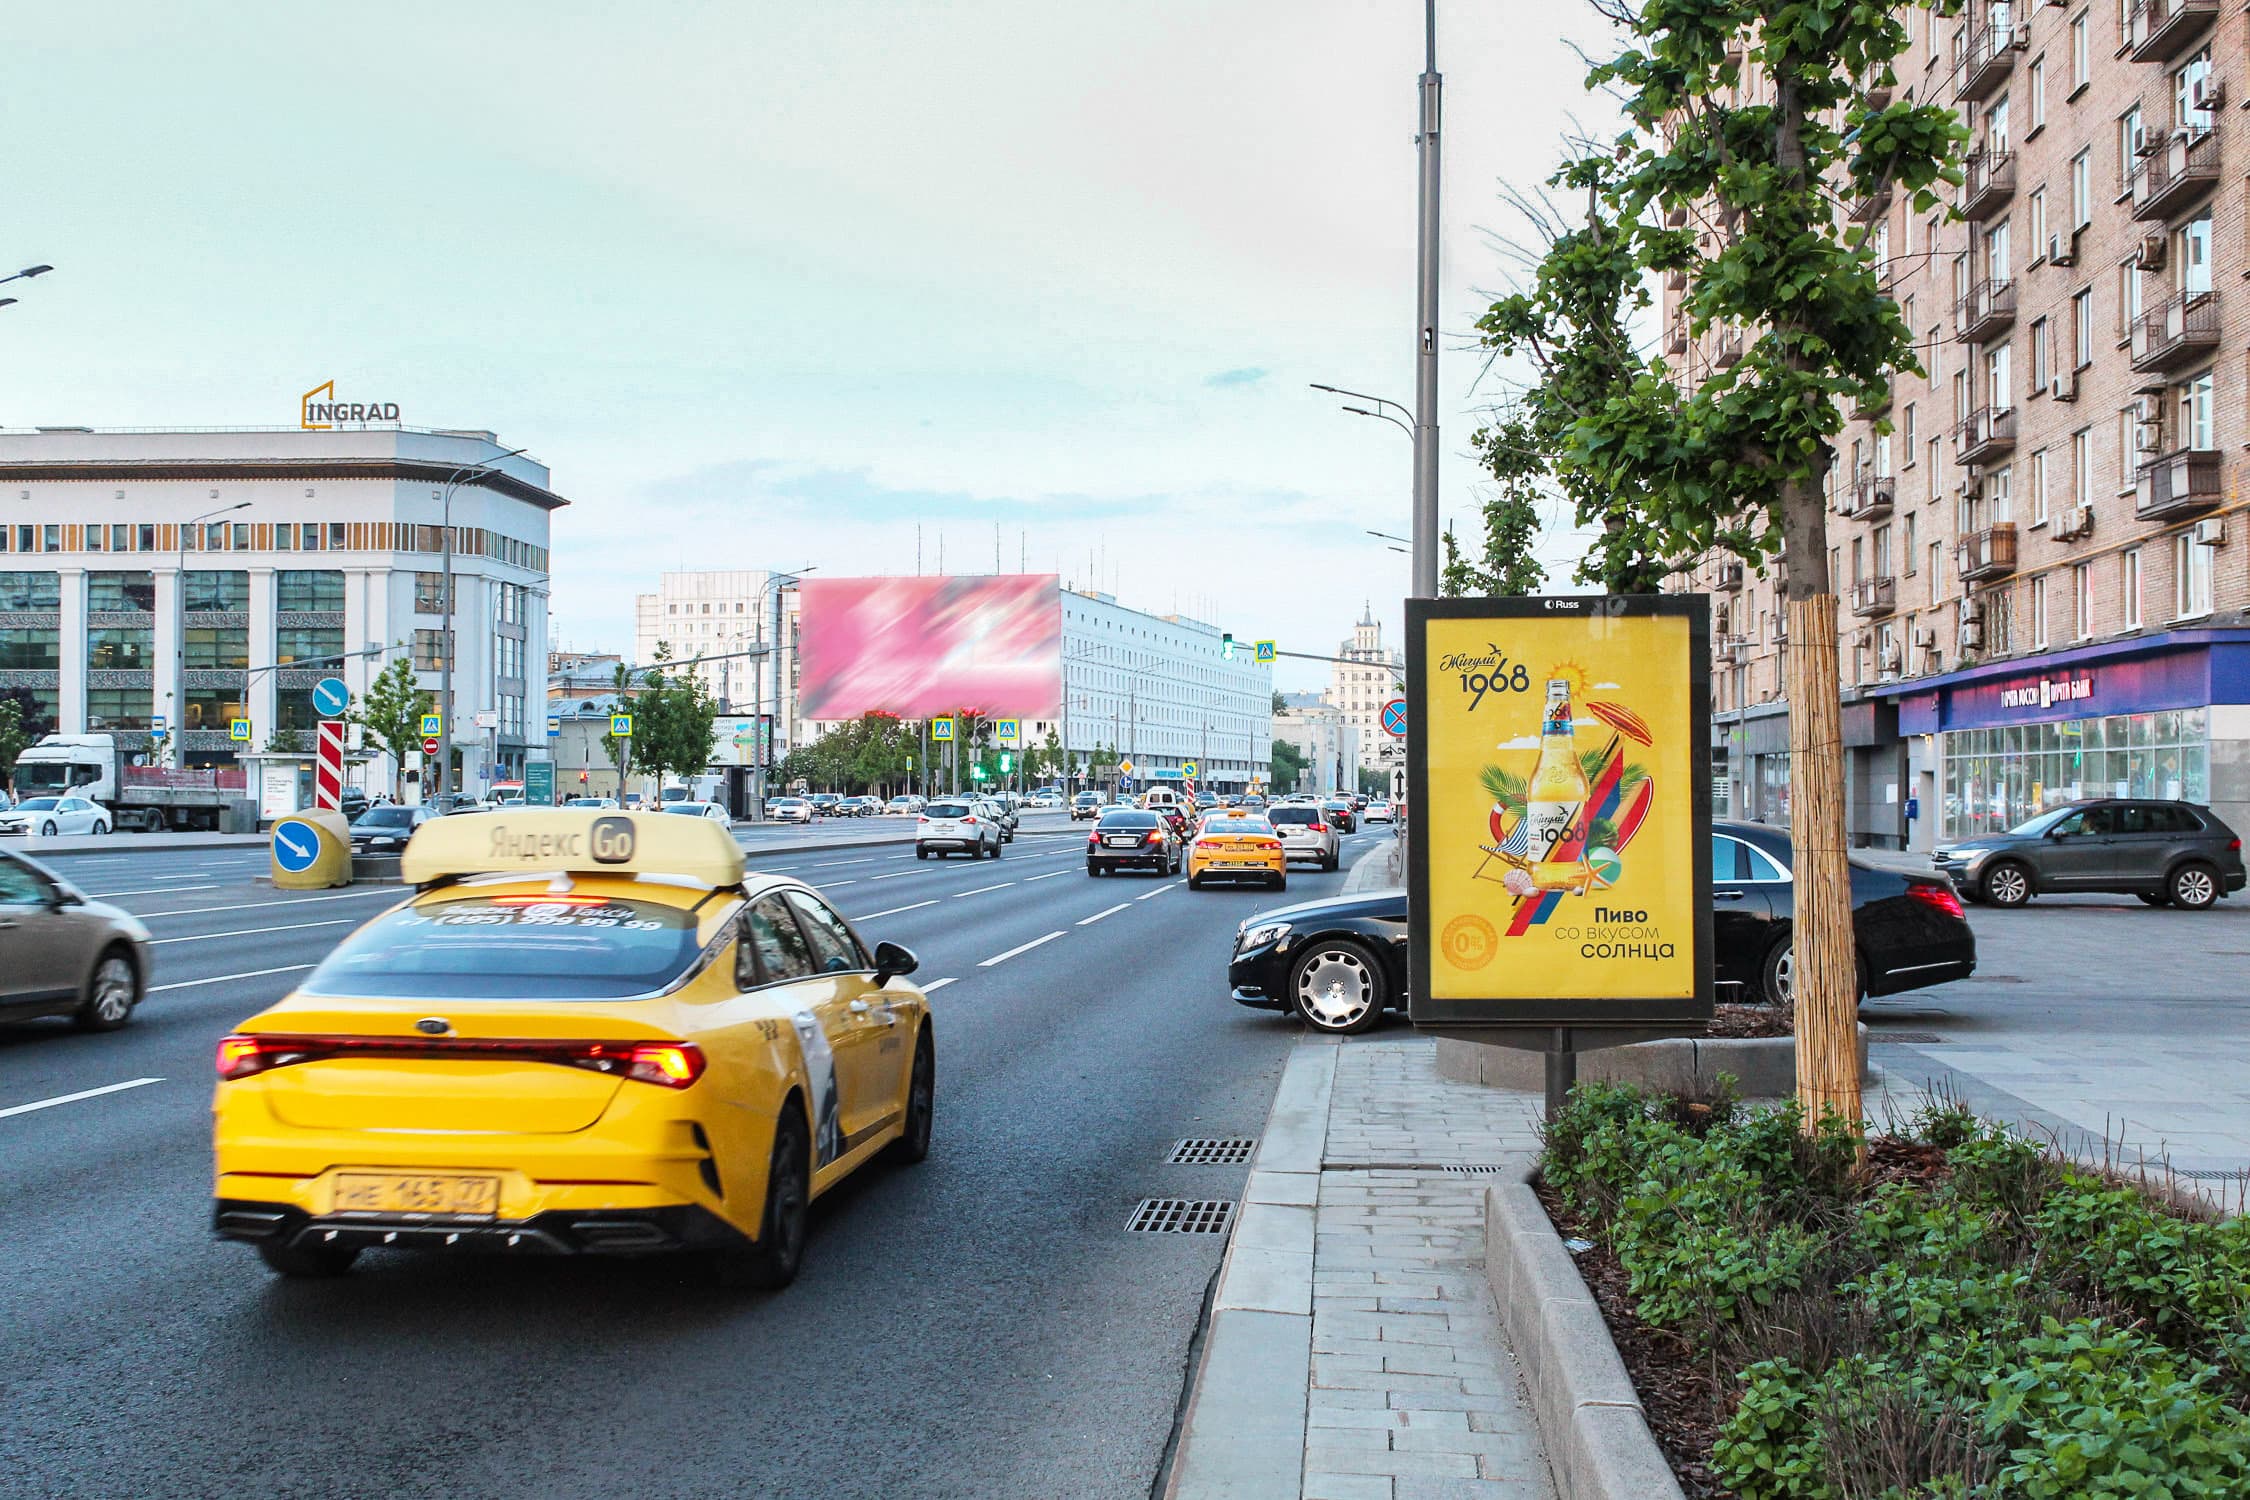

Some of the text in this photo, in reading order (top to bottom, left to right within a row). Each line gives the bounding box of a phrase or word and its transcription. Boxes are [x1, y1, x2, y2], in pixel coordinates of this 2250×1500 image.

[309, 402, 400, 421] INGRAD
[1555, 600, 1579, 609] Russ
[1440, 652, 1496, 672] Жигули
[1459, 658, 1530, 711] 1968
[2071, 679, 2090, 700] БАНК
[488, 823, 633, 861] Яндекс Go
[433, 914, 511, 926] (495)
[523, 915, 575, 926] 999
[578, 917, 620, 928] 99
[620, 920, 663, 931] 99
[1595, 907, 1648, 923] Пиво
[1555, 927, 1660, 942] со вкусом
[1581, 943, 1674, 961] солнца
